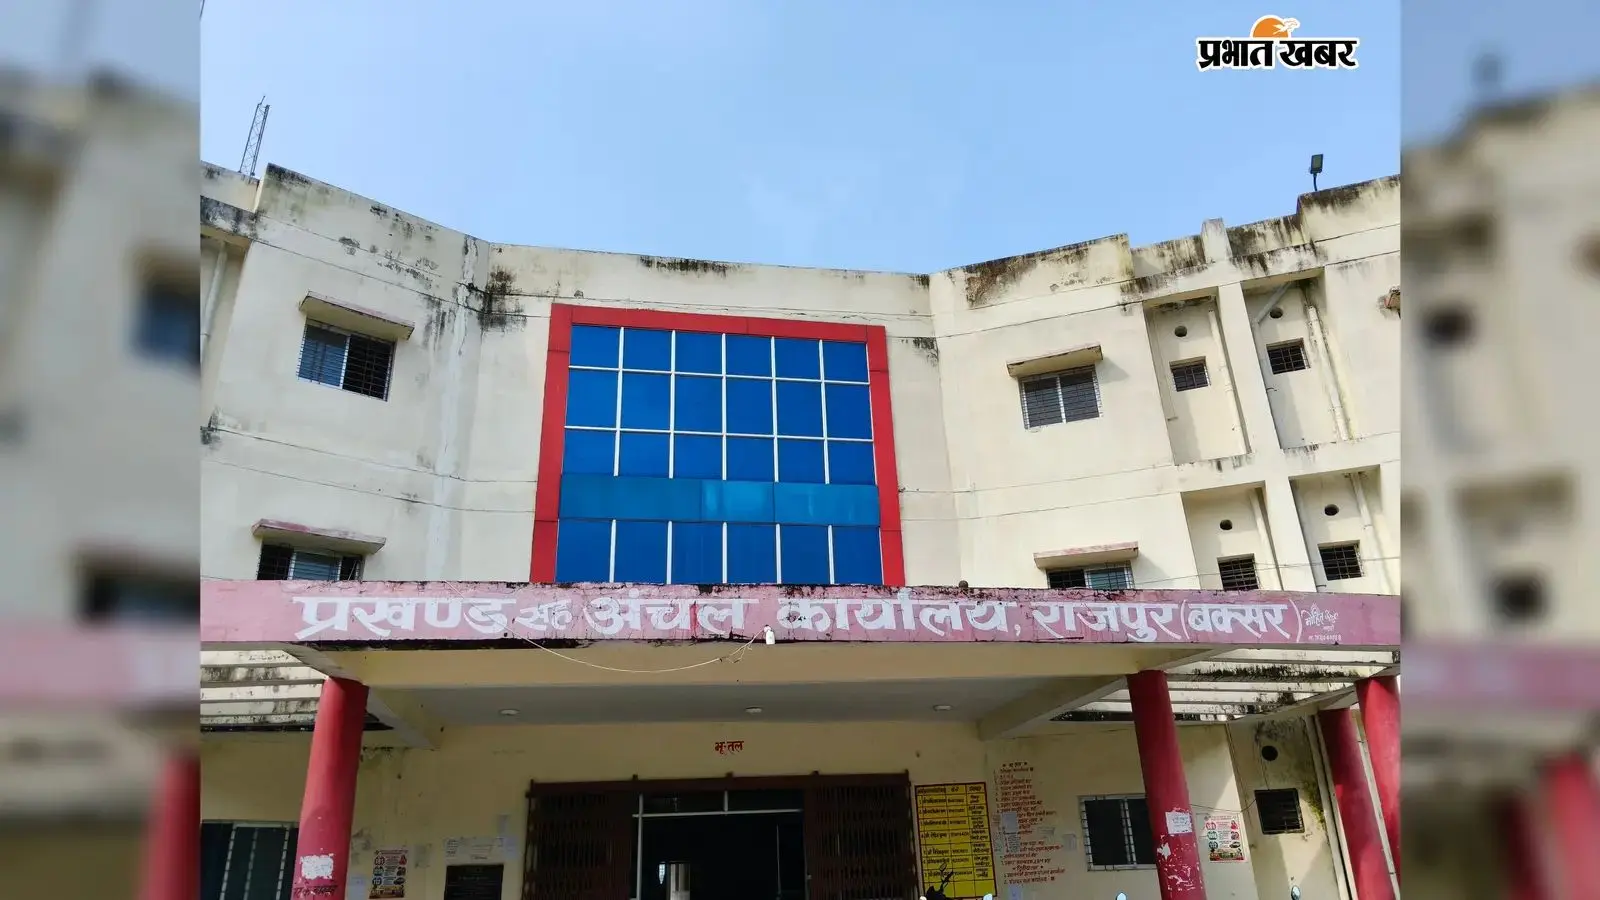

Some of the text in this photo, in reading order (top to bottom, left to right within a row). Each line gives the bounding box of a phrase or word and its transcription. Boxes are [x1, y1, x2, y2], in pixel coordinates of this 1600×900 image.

[293, 596, 516, 640] प्रखण्ड
[515, 599, 573, 631] सह
[583, 588, 759, 636] अंचल
[1031, 601, 1181, 642] राजपुर
